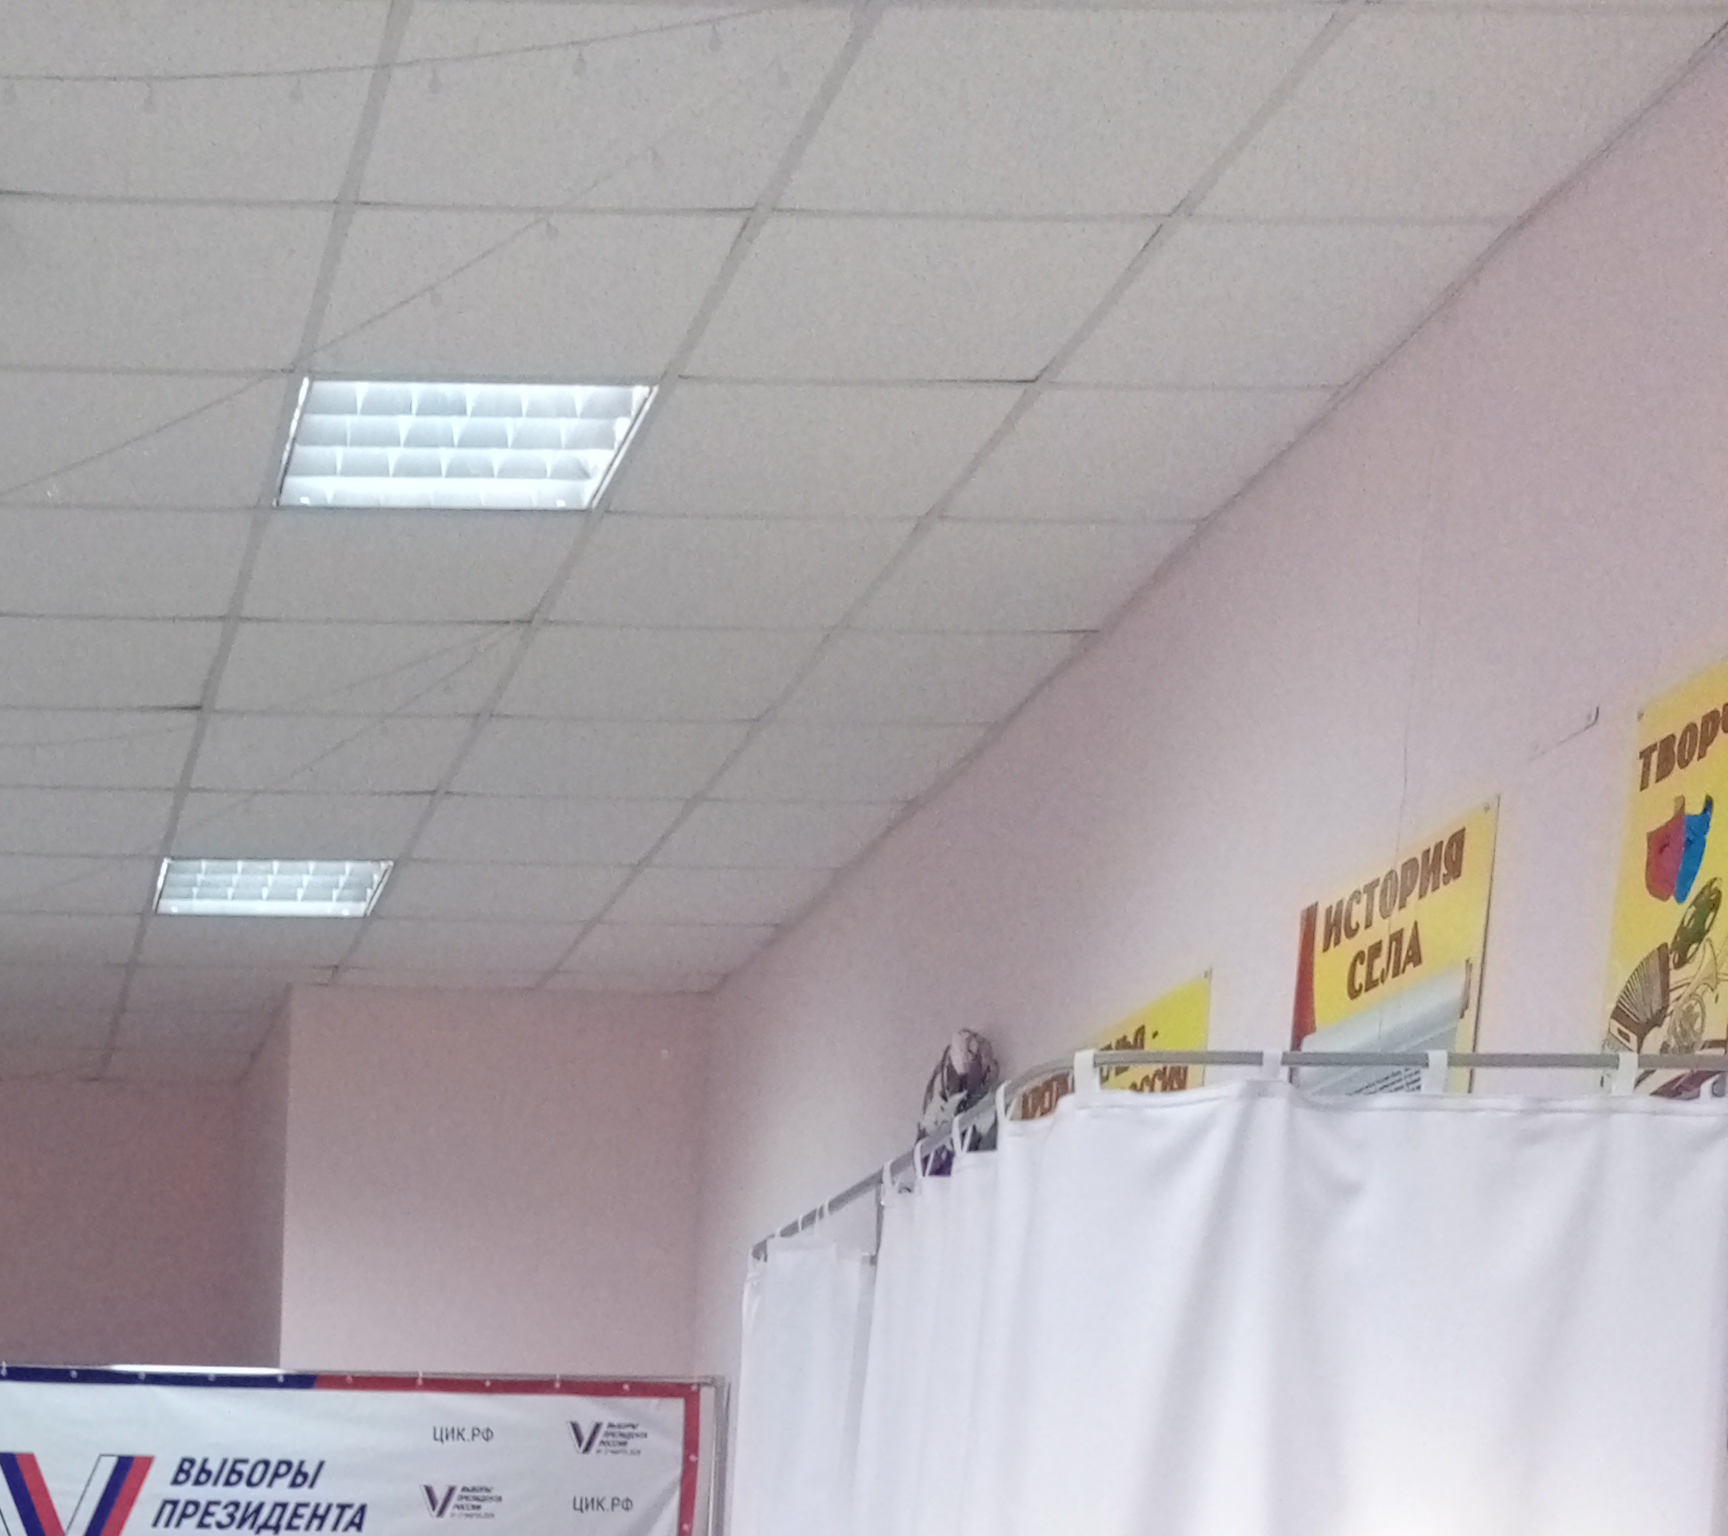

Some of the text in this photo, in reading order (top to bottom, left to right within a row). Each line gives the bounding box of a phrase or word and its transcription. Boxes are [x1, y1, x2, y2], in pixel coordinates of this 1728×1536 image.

[1322, 826, 1466, 953] ИСТОРИЯ
[1347, 920, 1423, 1000] СЕЛА
[432, 1426, 494, 1444] ЦИК.РФ
[170, 1457, 325, 1489] ВЫБОРЫ
[152, 1499, 367, 1535] ПРЕЗИДЕНТА
[572, 1495, 634, 1514] ЦИК.РФ
